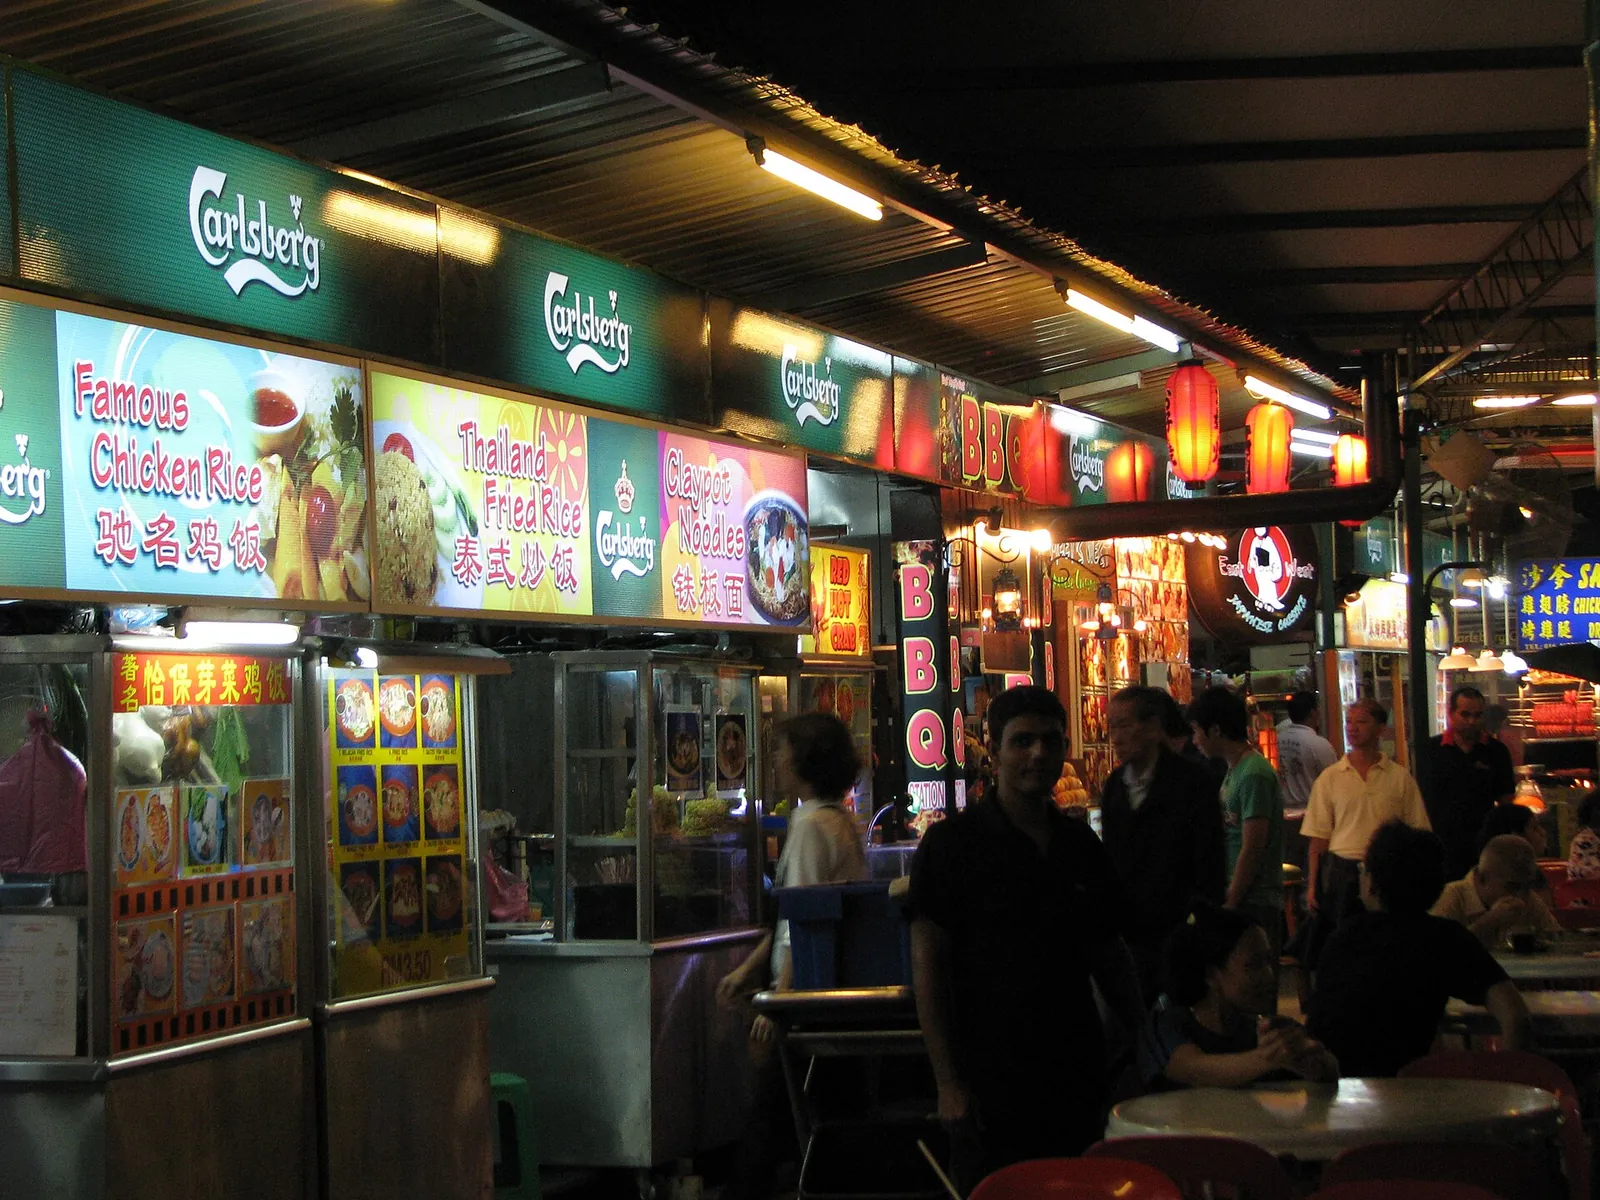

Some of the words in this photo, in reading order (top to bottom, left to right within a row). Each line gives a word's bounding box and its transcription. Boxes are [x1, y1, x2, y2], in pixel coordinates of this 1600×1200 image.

[189, 165, 321, 297] Carlsberg
[544, 271, 630, 374] Carlsberg
[75, 358, 190, 431] Famous
[780, 343, 839, 427] Carlsberg
[91, 431, 203, 501] Chicken
[206, 446, 263, 504] Rice
[459, 420, 548, 480] Thailand
[961, 393, 1031, 497] BBQ
[1069, 433, 1104, 493] Carlsberg
[484, 477, 537, 533] Fried
[540, 484, 583, 538] Rice
[665, 448, 733, 520] Claypot
[96, 510, 267, 573] 驰名鸡饭
[453, 533, 579, 593] 泰式炒饭
[596, 510, 655, 581] Carlsberg
[677, 506, 745, 560] Noodles
[671, 563, 746, 617] 铁板面
[829, 554, 850, 586] RED
[1218, 555, 1244, 578] East
[829, 588, 851, 619] HOT
[830, 622, 857, 652] CRAB
[901, 564, 948, 770] BBQ
